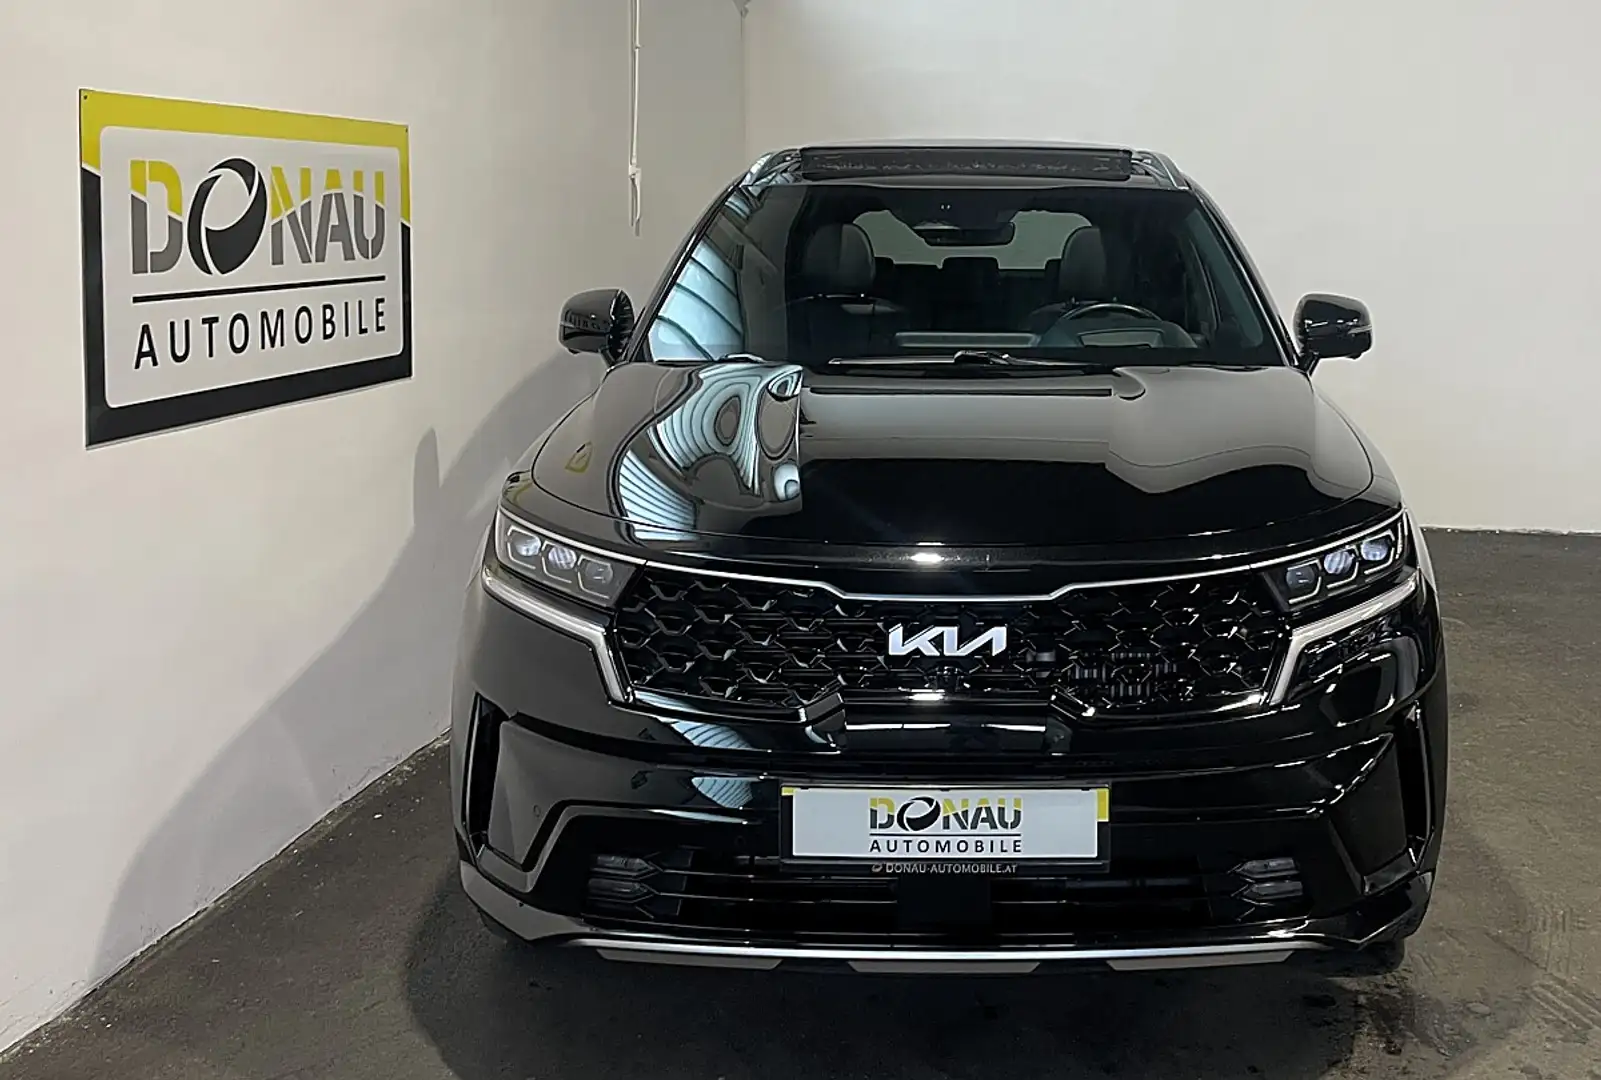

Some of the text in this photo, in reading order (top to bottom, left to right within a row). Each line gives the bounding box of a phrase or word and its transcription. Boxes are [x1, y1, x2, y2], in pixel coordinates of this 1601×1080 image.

[130, 158, 385, 275] DONAU
[134, 298, 386, 370] AUTOMOBILE
[888, 626, 1007, 656] KIA
[869, 796, 1022, 831] DONAU
[869, 839, 1022, 853] AUTOMOBILE
